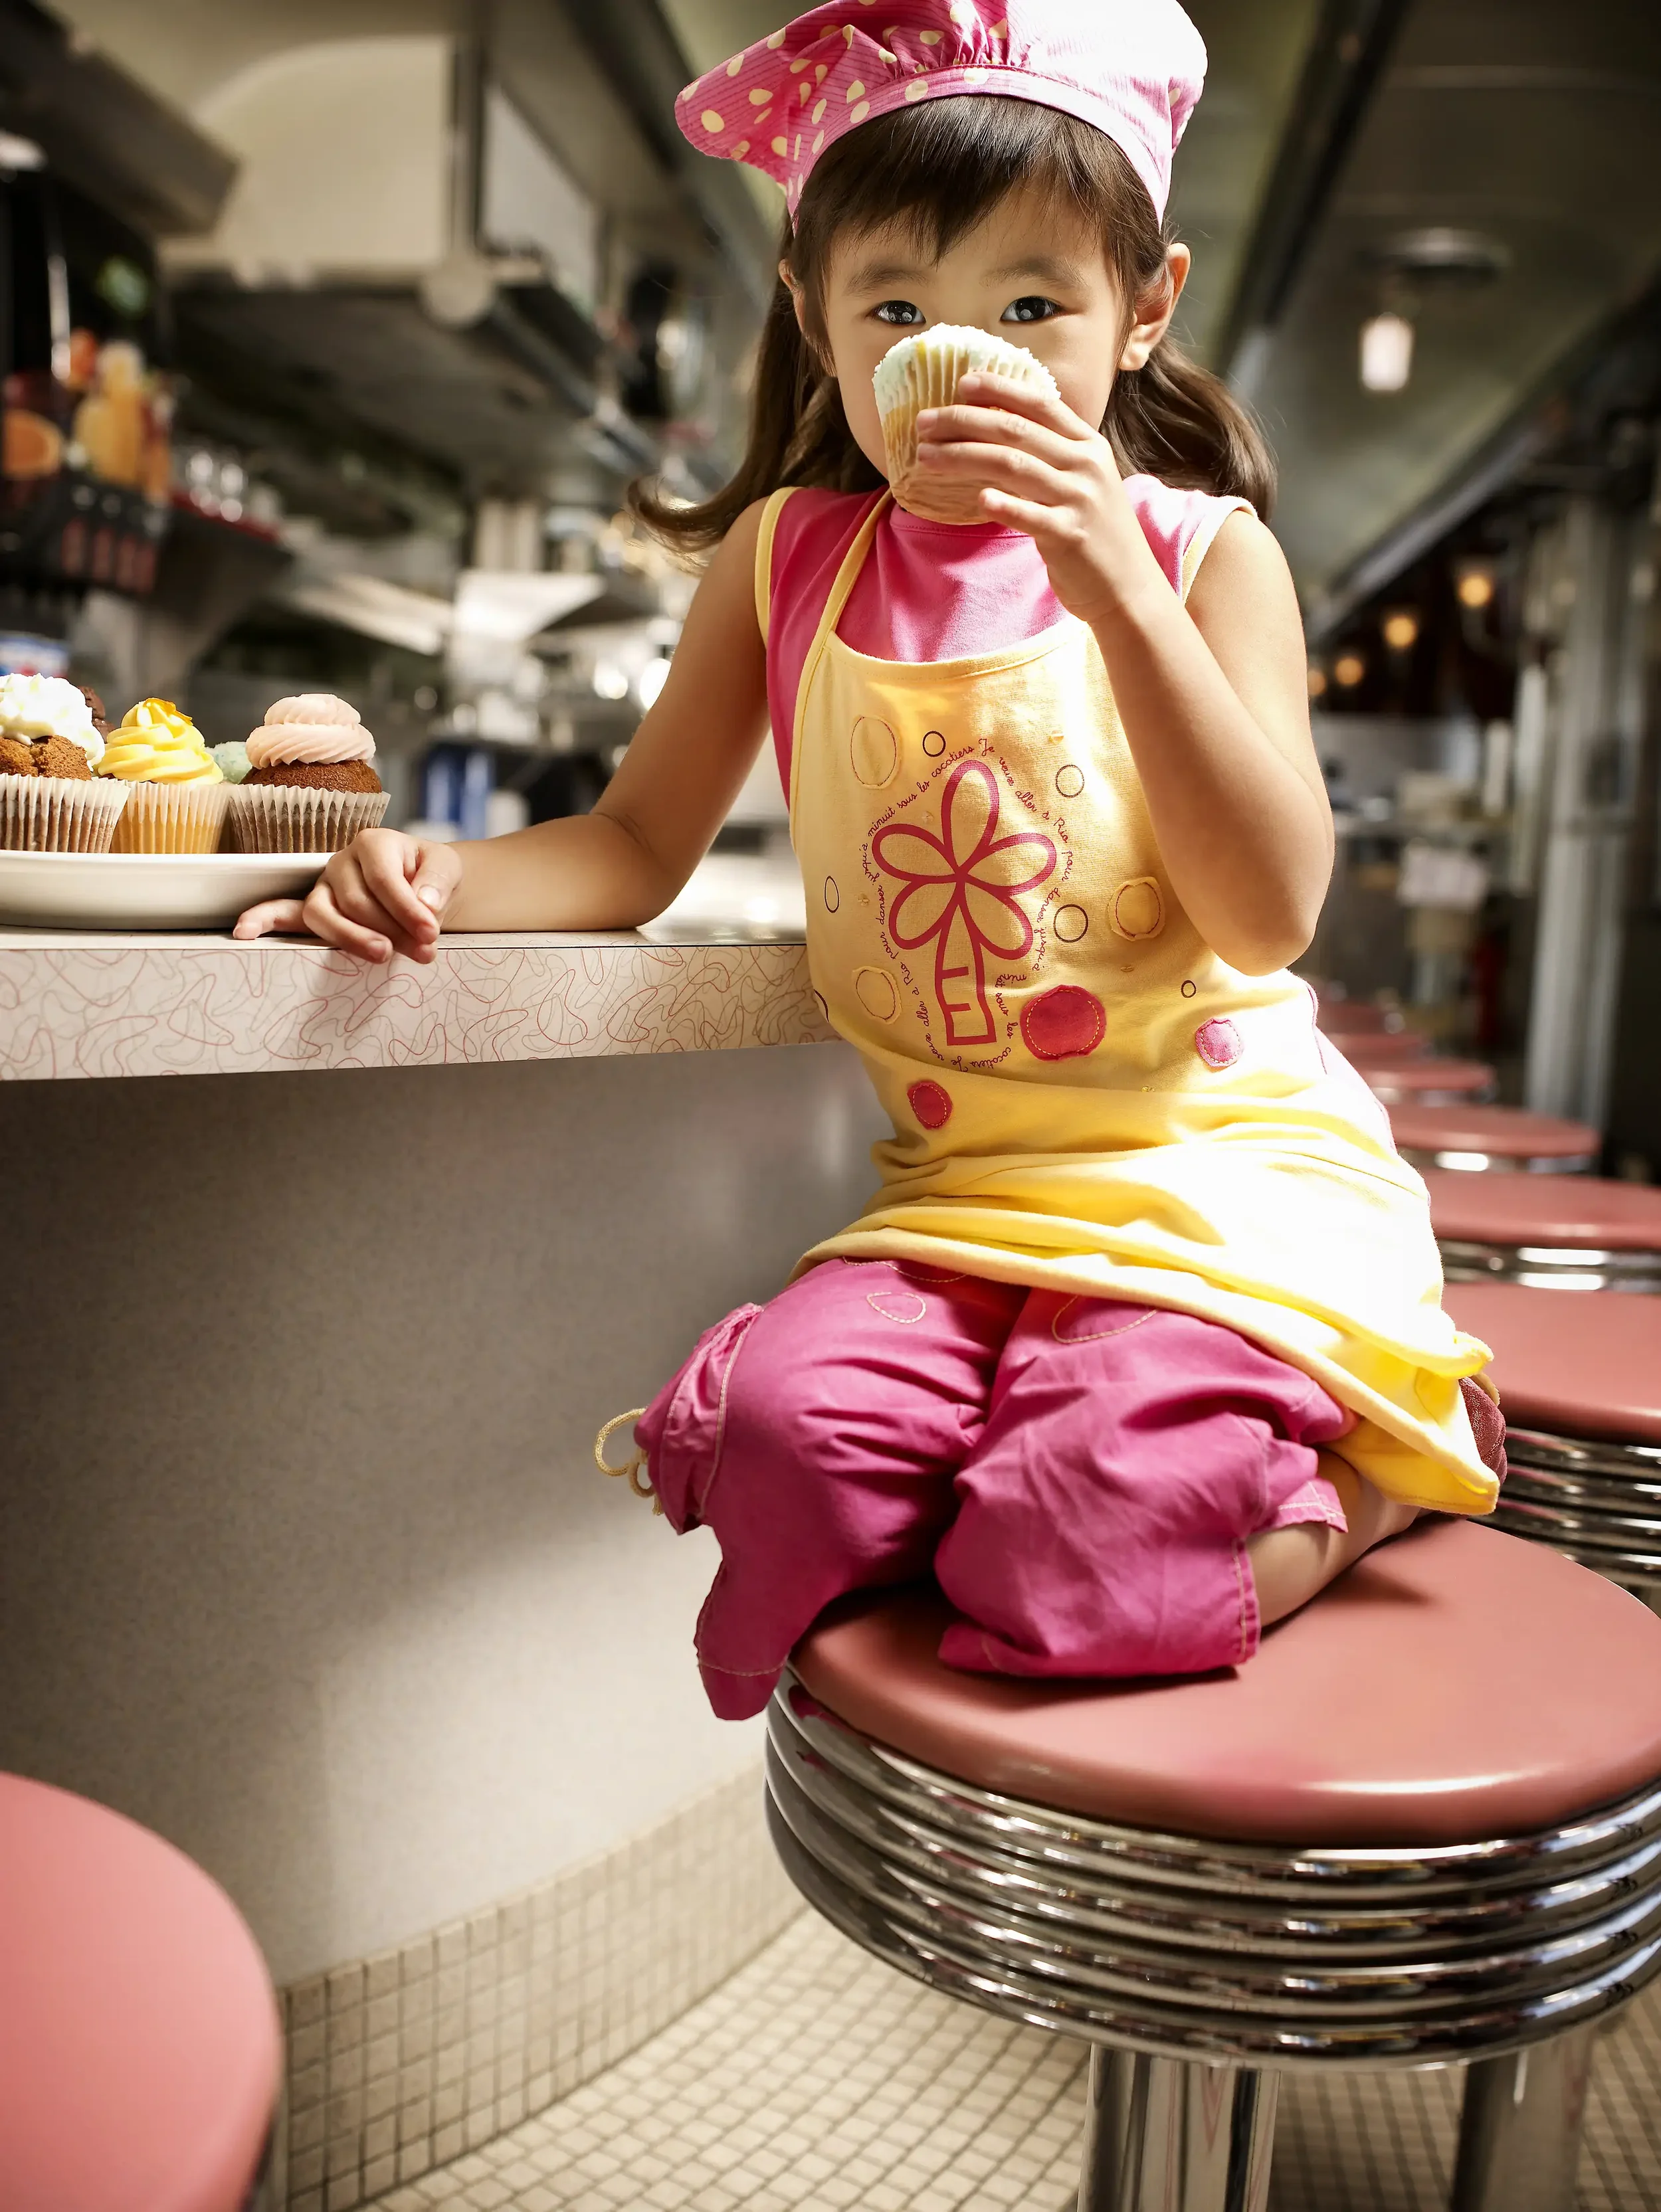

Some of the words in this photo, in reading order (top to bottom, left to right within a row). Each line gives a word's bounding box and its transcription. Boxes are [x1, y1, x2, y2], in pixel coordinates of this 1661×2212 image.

[978, 738, 995, 757] Je
[931, 746, 975, 777] cocotiers
[917, 781, 929, 792] les
[896, 793, 918, 808] sous
[1015, 790, 1037, 812] aller
[868, 806, 896, 836] minuit
[1053, 817, 1068, 844] Rio
[1061, 850, 1073, 881] pour
[876, 885, 885, 925] danser
[1037, 887, 1060, 923] danser
[880, 932, 898, 959] pour
[900, 963, 914, 985] Rio
[916, 1001, 929, 1026] aller
[995, 993, 1009, 1016] sous
[1007, 1022, 1018, 1039] les
[951, 1056, 968, 1072] Je
[969, 1047, 1011, 1069] cocotiers
